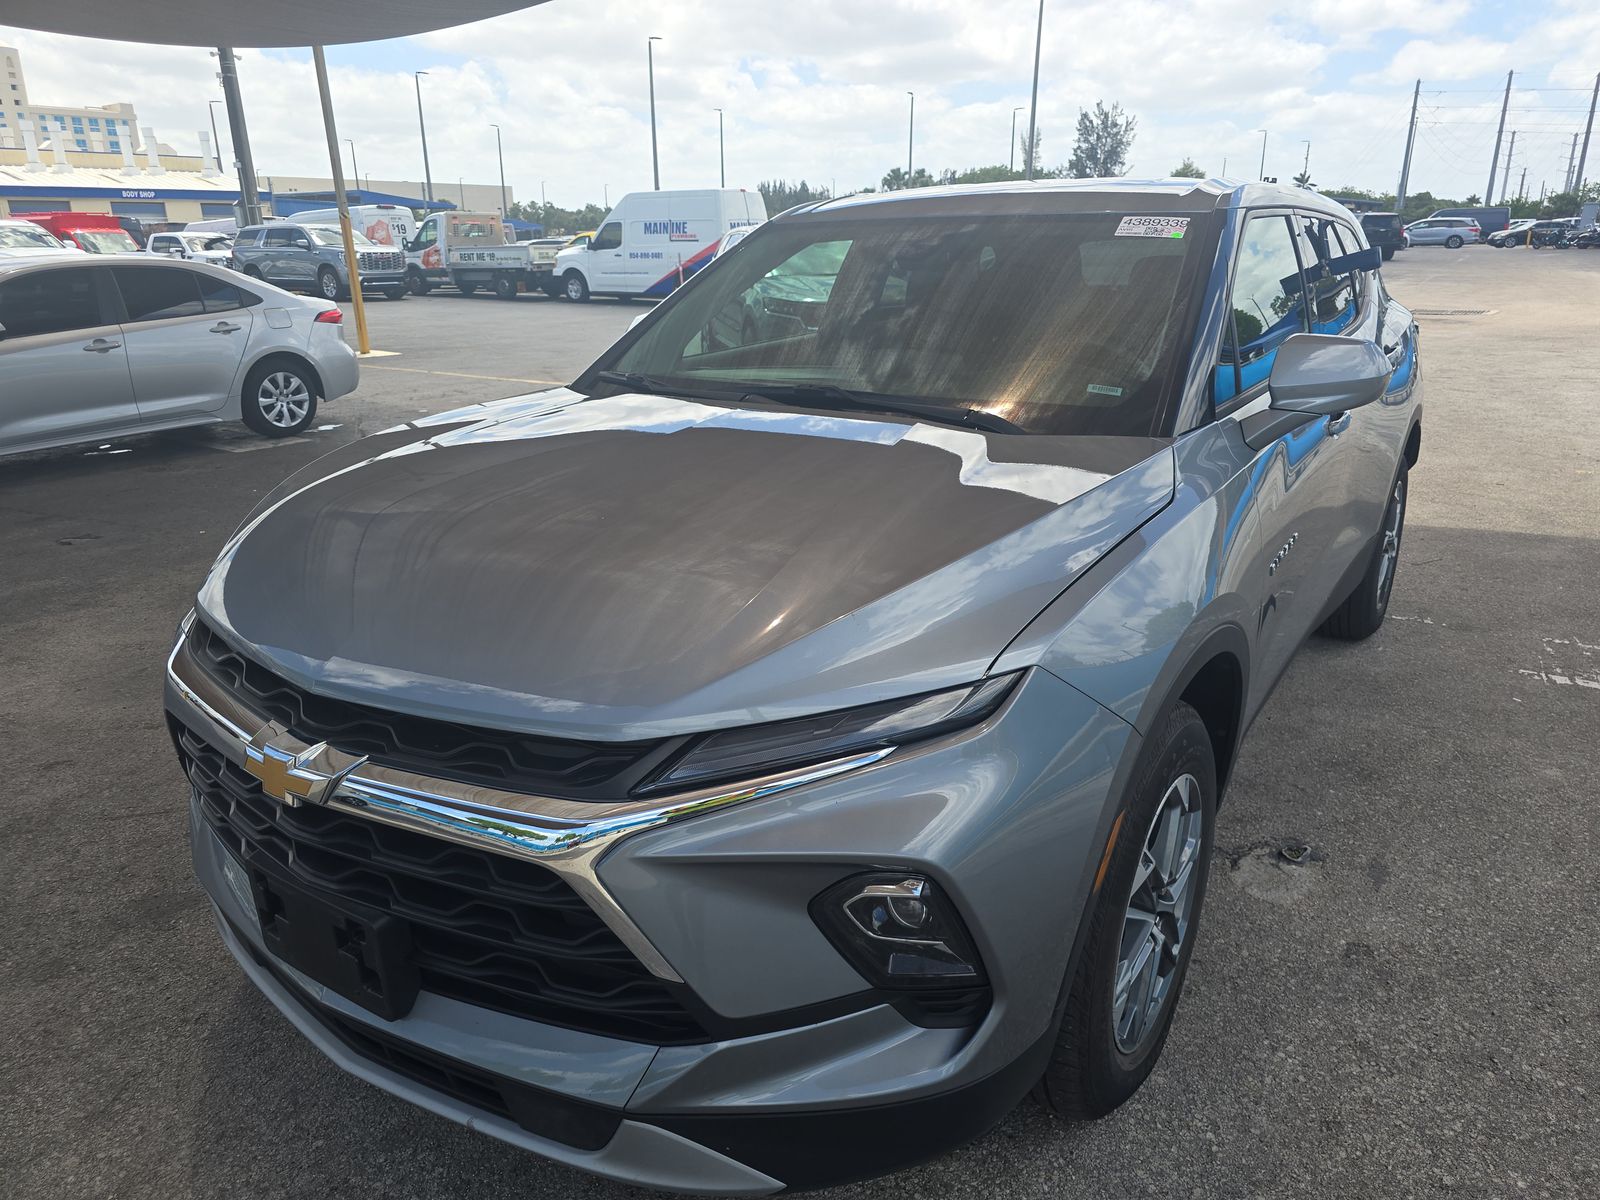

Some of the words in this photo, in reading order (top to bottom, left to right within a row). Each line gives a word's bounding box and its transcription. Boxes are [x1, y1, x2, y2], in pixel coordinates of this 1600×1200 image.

[121, 190, 138, 198] BODY
[1123, 218, 1189, 228] 4389339
[392, 223, 407, 234] $19
[459, 252, 474, 261] RENT
[476, 252, 486, 261] ME
